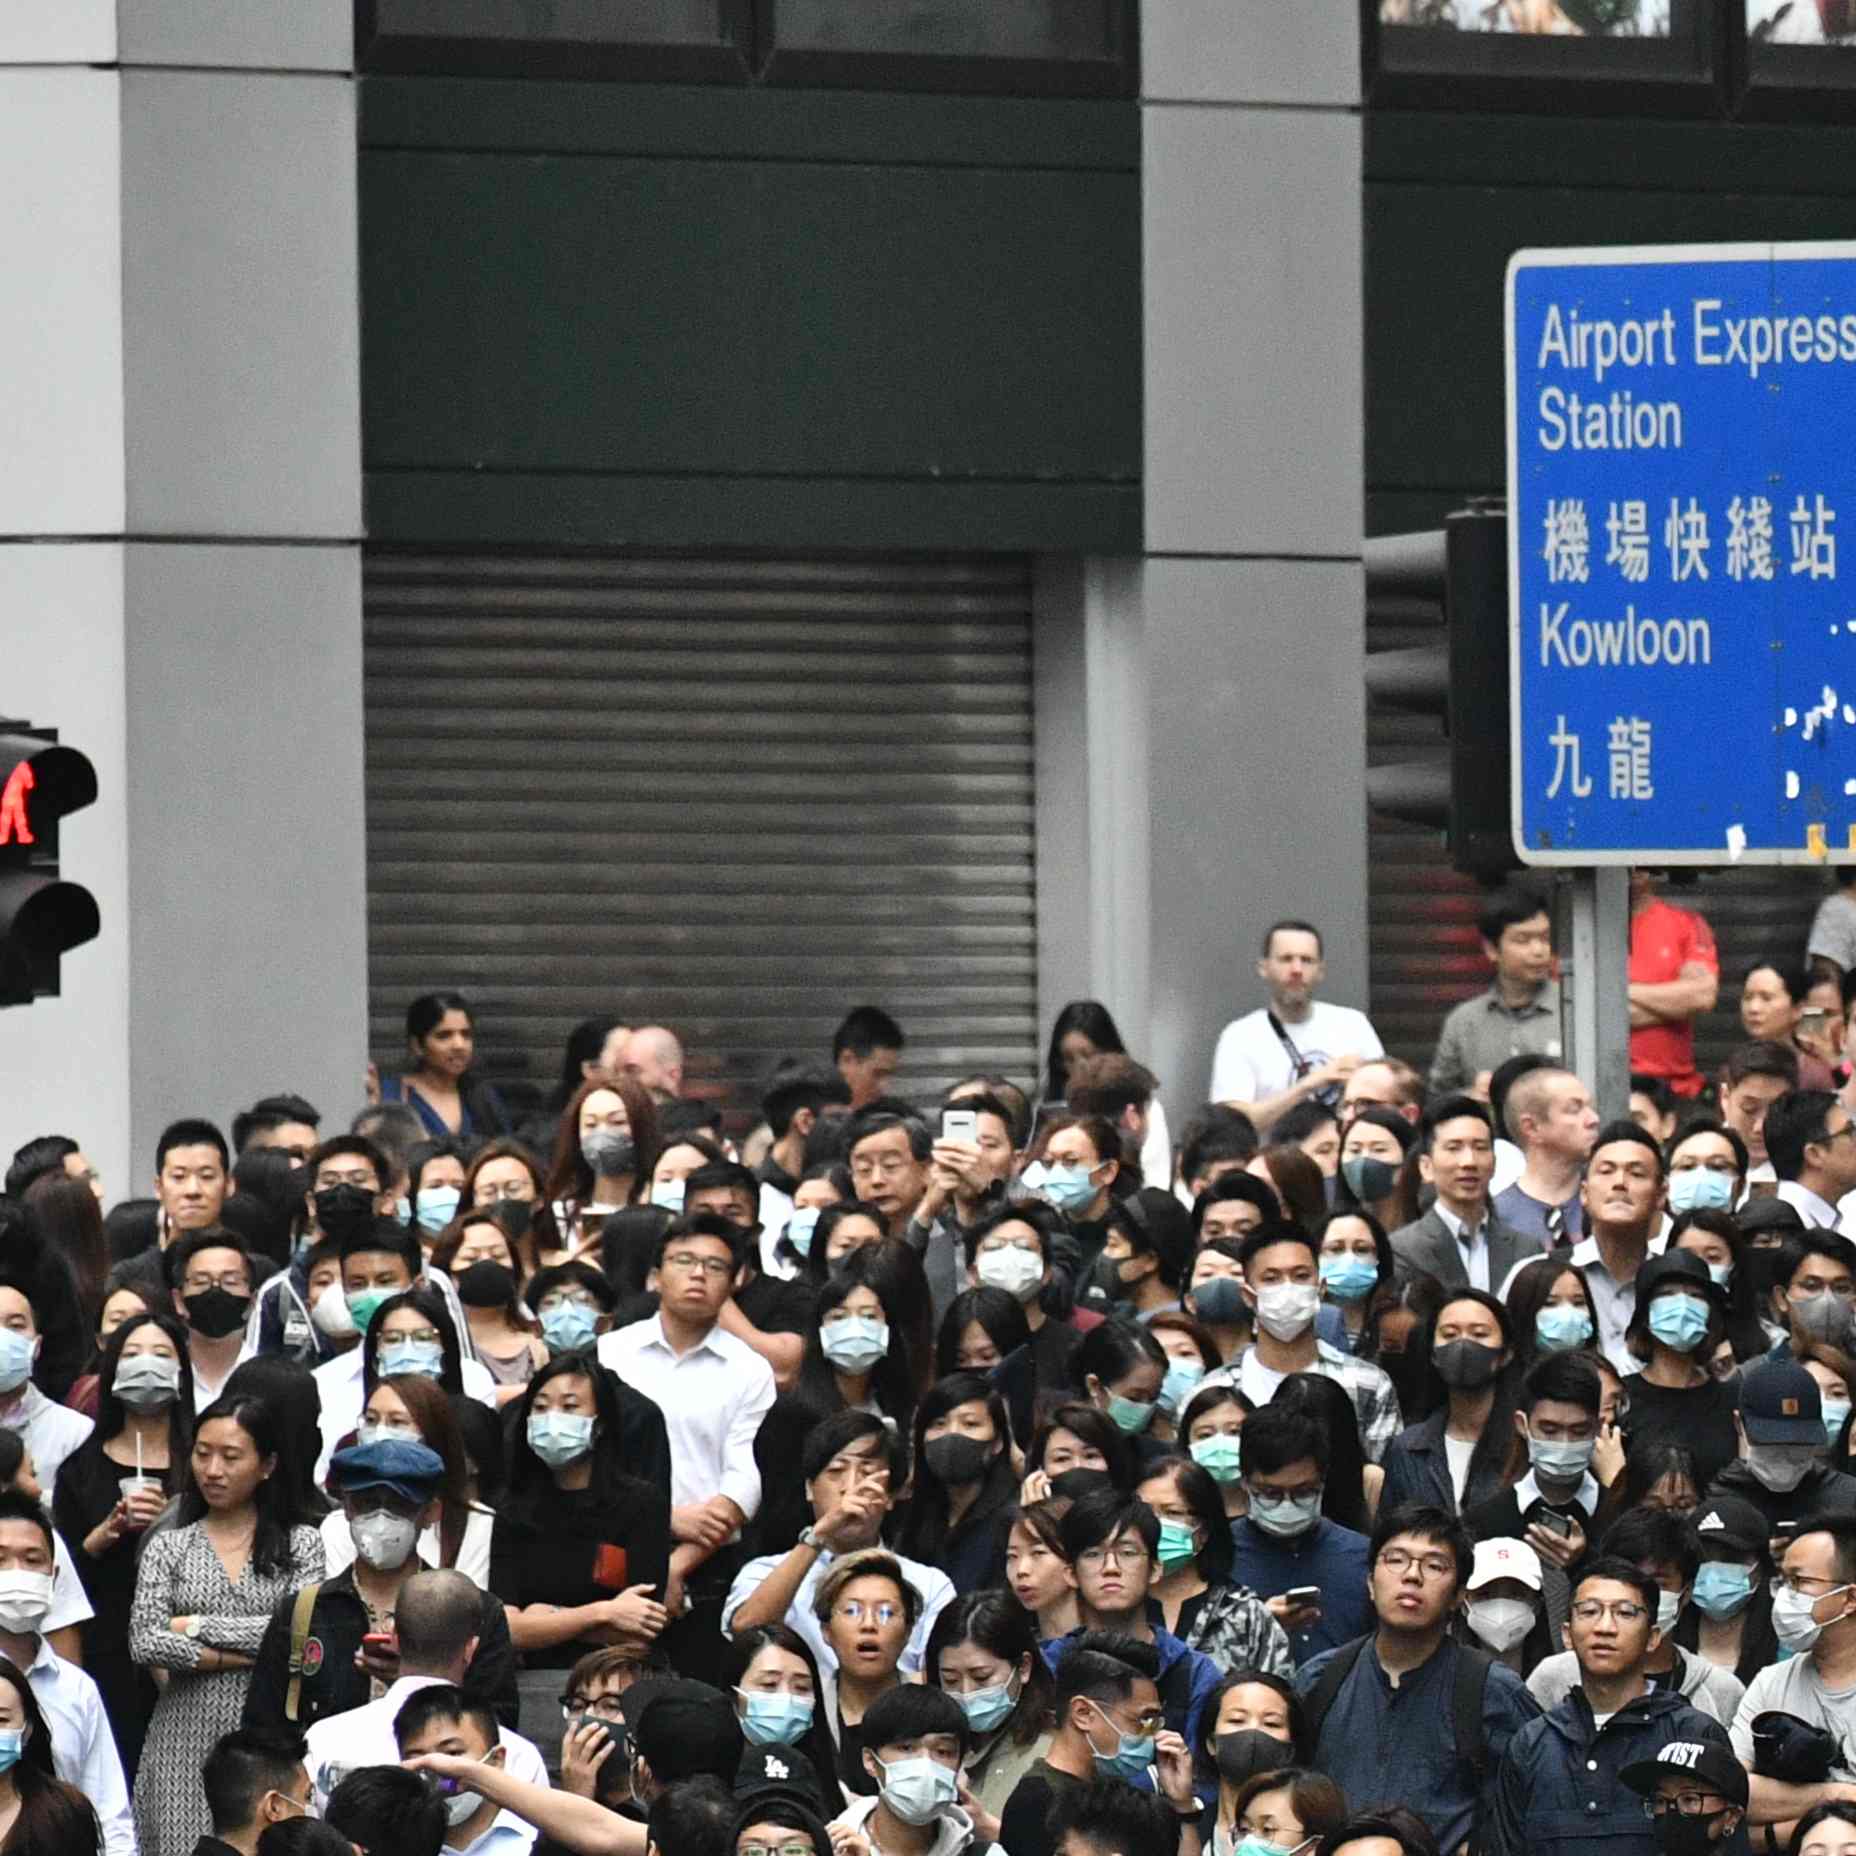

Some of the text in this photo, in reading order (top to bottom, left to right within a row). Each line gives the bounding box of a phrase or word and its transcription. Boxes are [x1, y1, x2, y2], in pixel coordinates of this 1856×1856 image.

[1538, 303, 1676, 382] Airport
[1539, 386, 1683, 451] Station
[1540, 603, 1711, 667] Kowloon
[1546, 714, 1654, 800] 九龍
